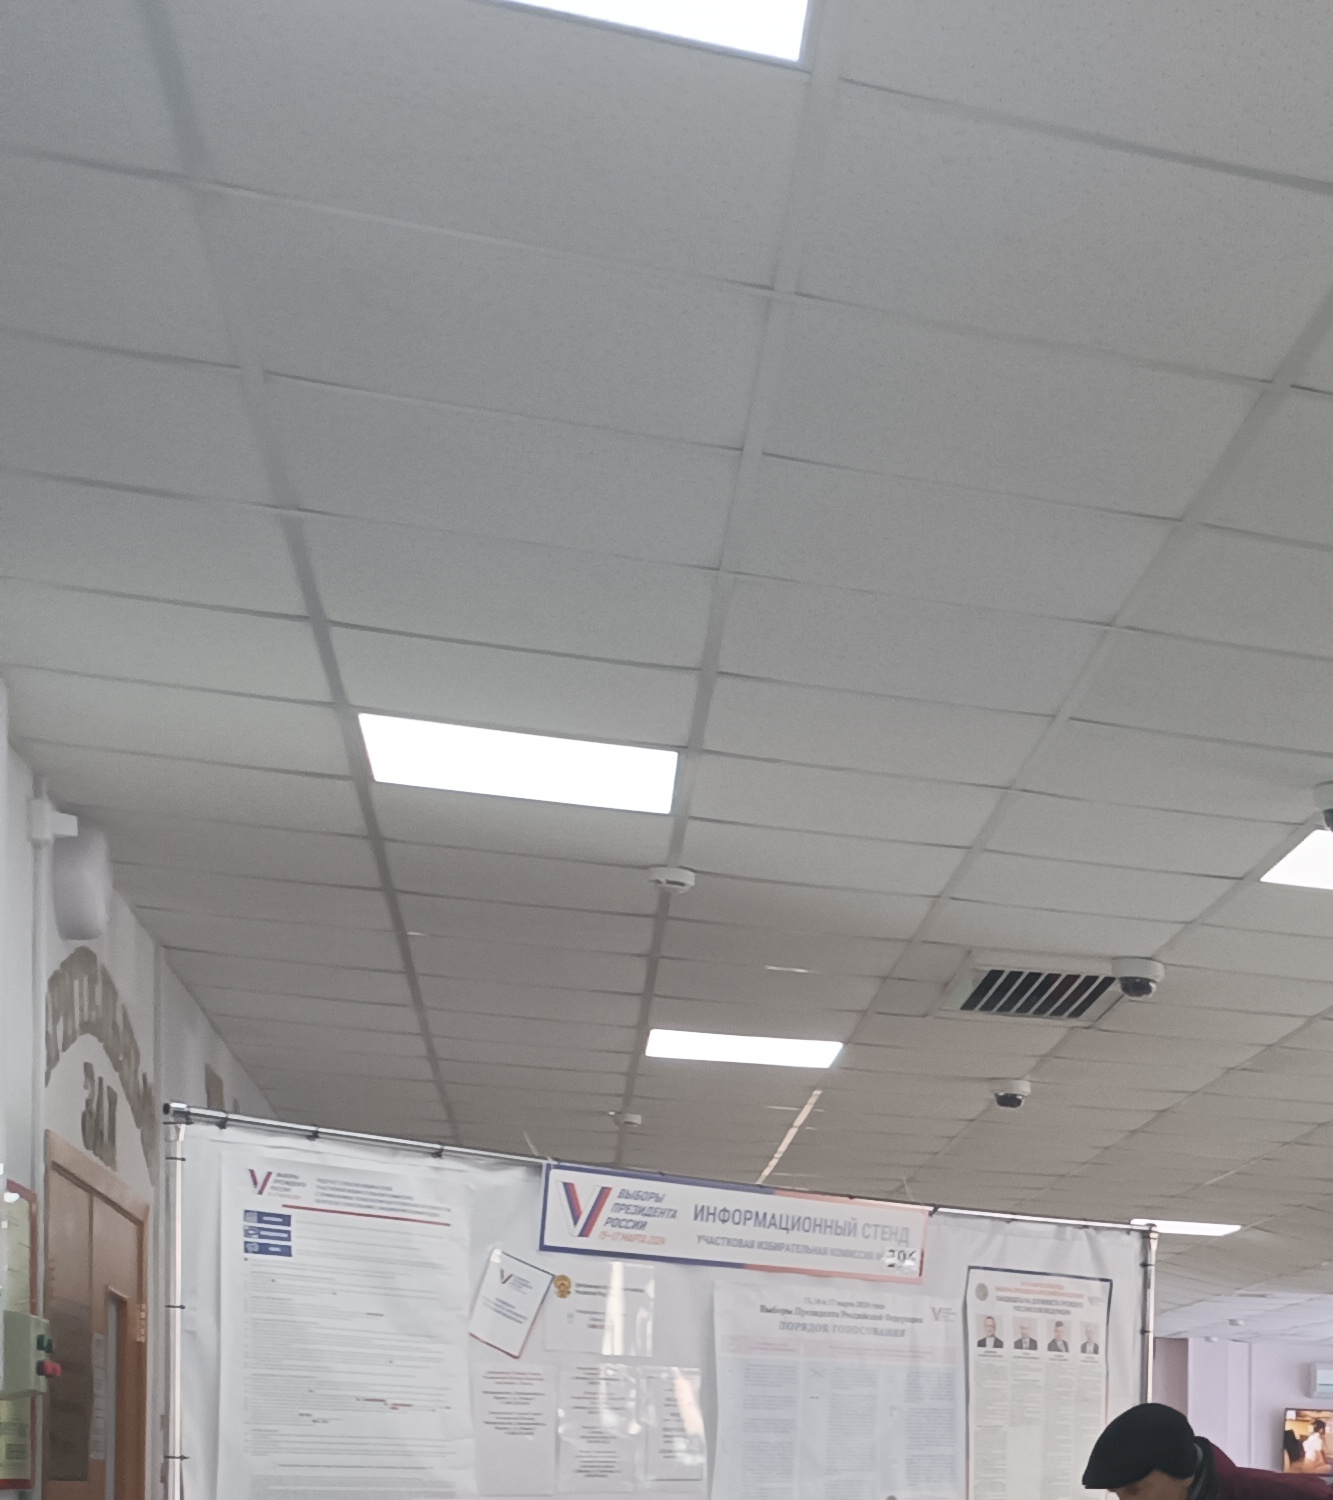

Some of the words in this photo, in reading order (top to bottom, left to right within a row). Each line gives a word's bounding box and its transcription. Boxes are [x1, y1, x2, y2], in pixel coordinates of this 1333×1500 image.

[617, 1188, 666, 1204] ВЫБОРЫ
[610, 1202, 678, 1219] ПРЕЗИДЕНТА
[604, 1217, 649, 1231] РОССИИ
[693, 1204, 858, 1237] ИНФОРМАЦИОННЫЙ
[861, 1222, 910, 1246] СТЕНД
[696, 1235, 755, 1250] УЧАСТКОВАЯ
[756, 1240, 828, 1257] ИЗБИРАТЕЛЬНАЯ
